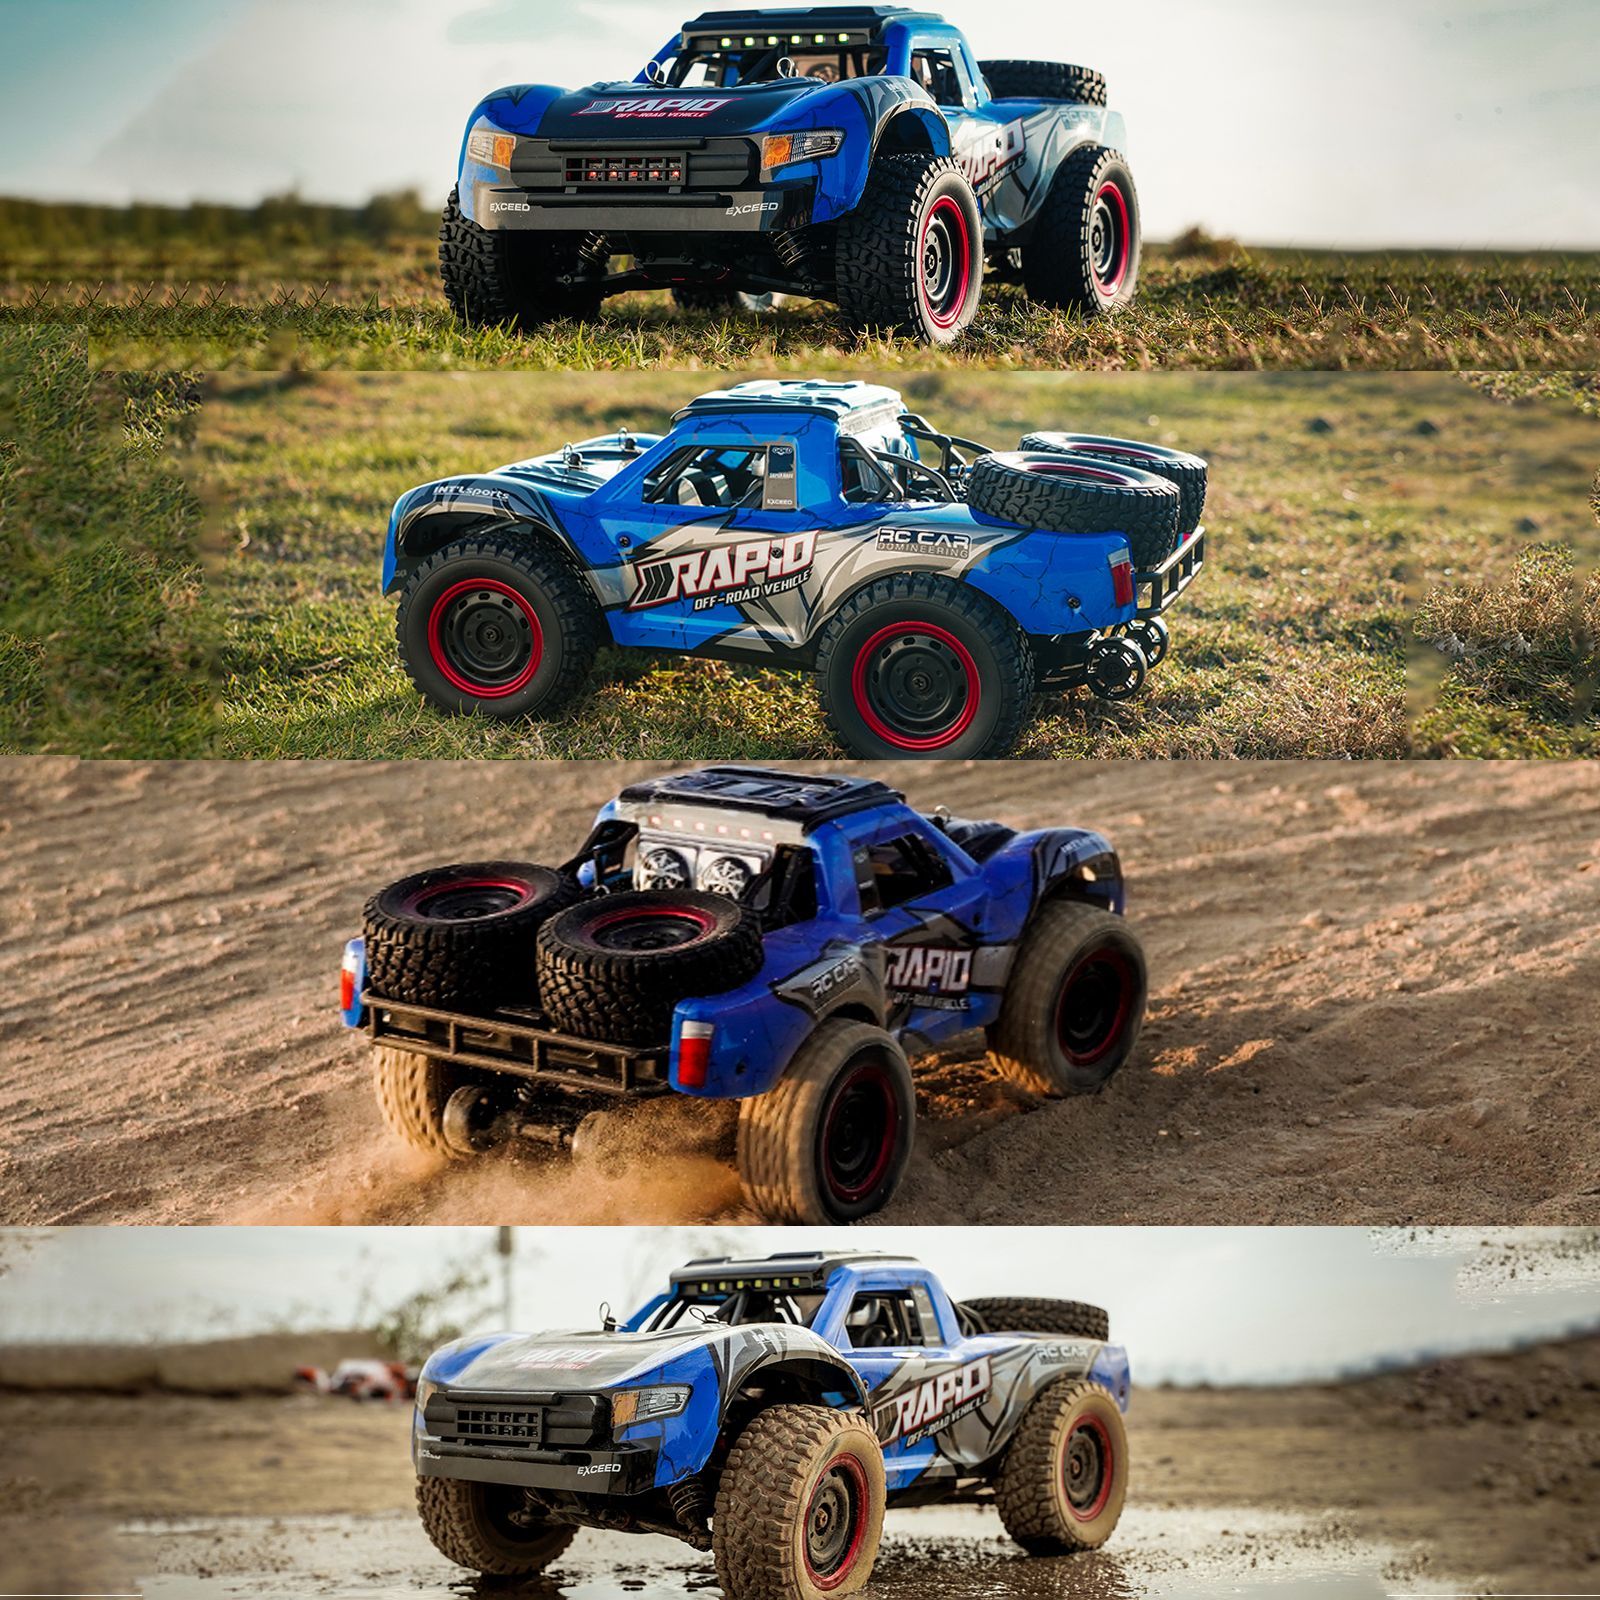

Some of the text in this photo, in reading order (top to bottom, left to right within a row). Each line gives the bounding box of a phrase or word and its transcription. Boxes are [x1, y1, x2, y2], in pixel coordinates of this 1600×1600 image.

[612, 98, 731, 112] RAPID
[489, 201, 531, 212] EXCEED
[725, 201, 779, 216] EXCEED
[879, 529, 969, 550] RC CAR
[877, 543, 969, 559] DOMINEERING
[670, 531, 818, 595] RAPID
[694, 569, 810, 611] OFF-ROAD VEHICLE
[883, 947, 972, 991] RAPID
[897, 1356, 990, 1433] RAPID
[577, 1463, 621, 1476] EXCEED
